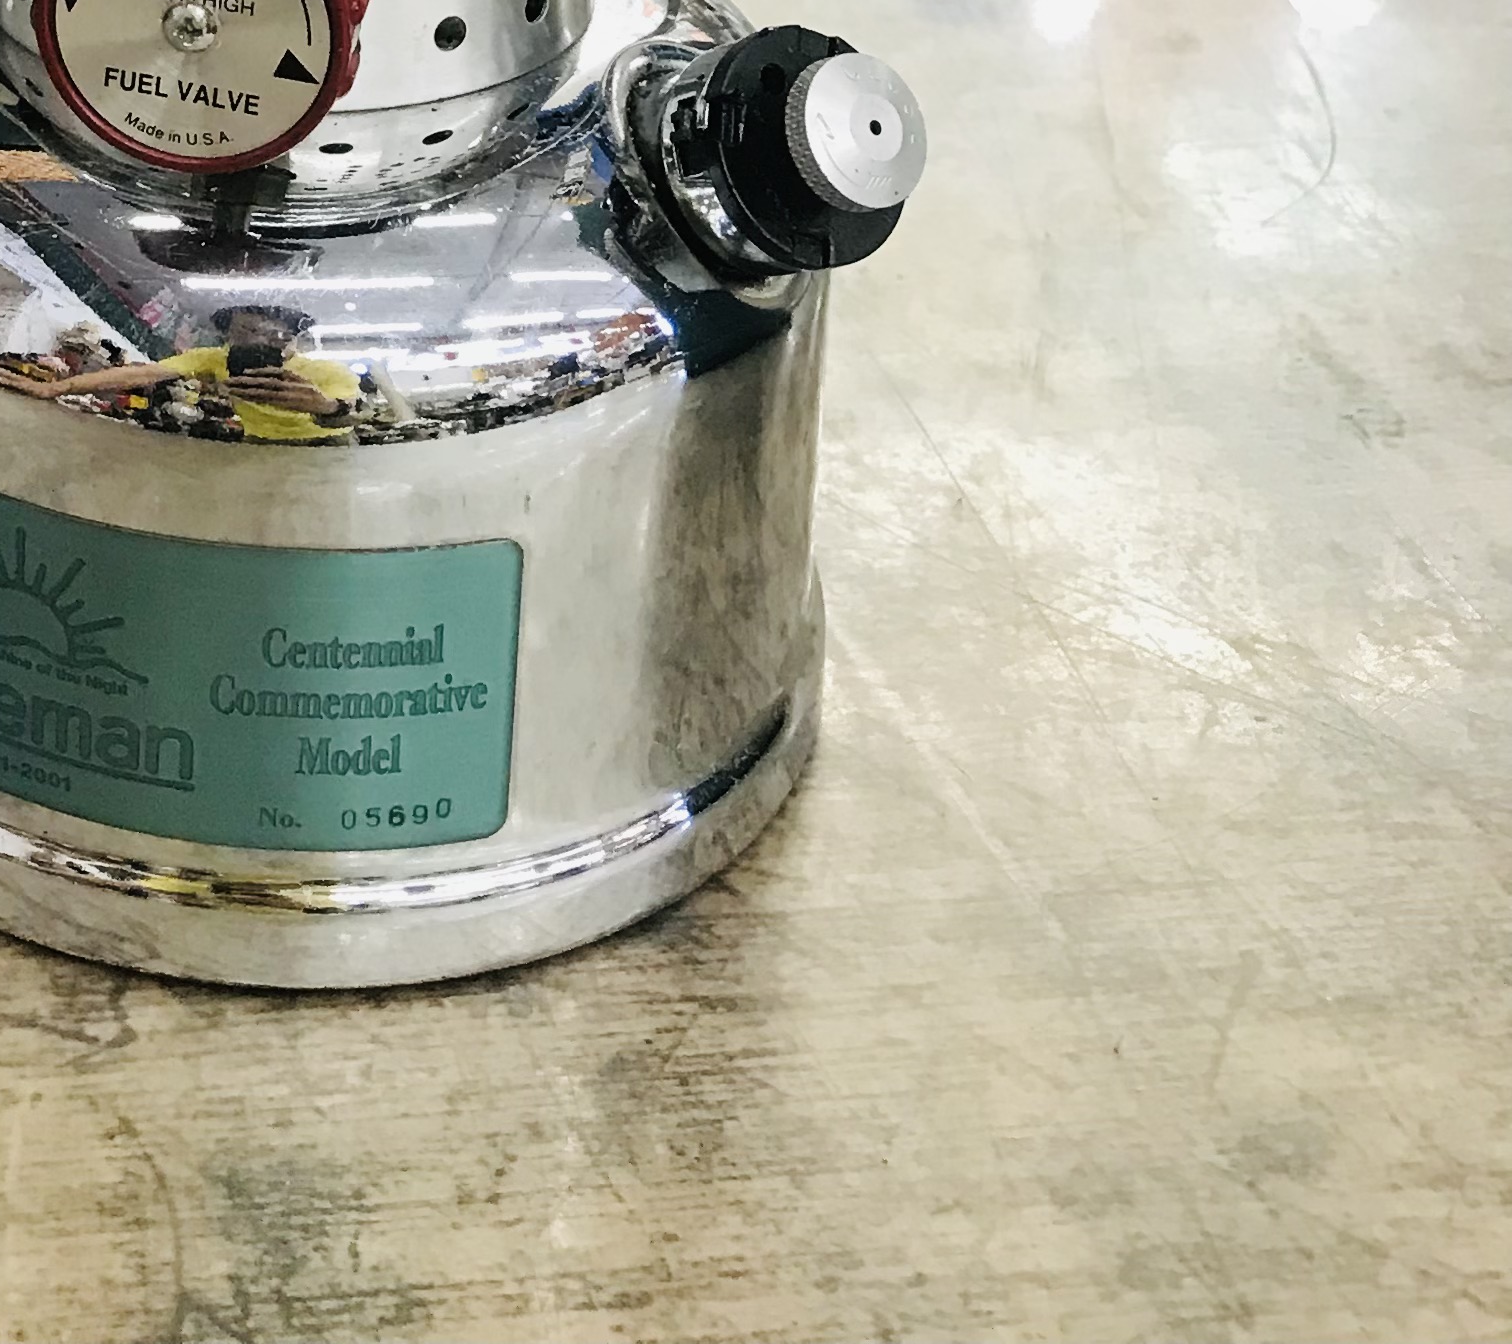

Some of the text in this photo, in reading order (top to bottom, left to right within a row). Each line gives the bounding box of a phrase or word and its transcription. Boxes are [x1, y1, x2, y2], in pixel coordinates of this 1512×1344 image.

[103, 66, 260, 116] FUEL VALVE
[124, 112, 165, 140] Made
[168, 130, 182, 144] in
[261, 623, 446, 669] Centennial
[209, 673, 488, 720] Commemorative
[294, 733, 403, 776] Model
[258, 806, 303, 829] No.
